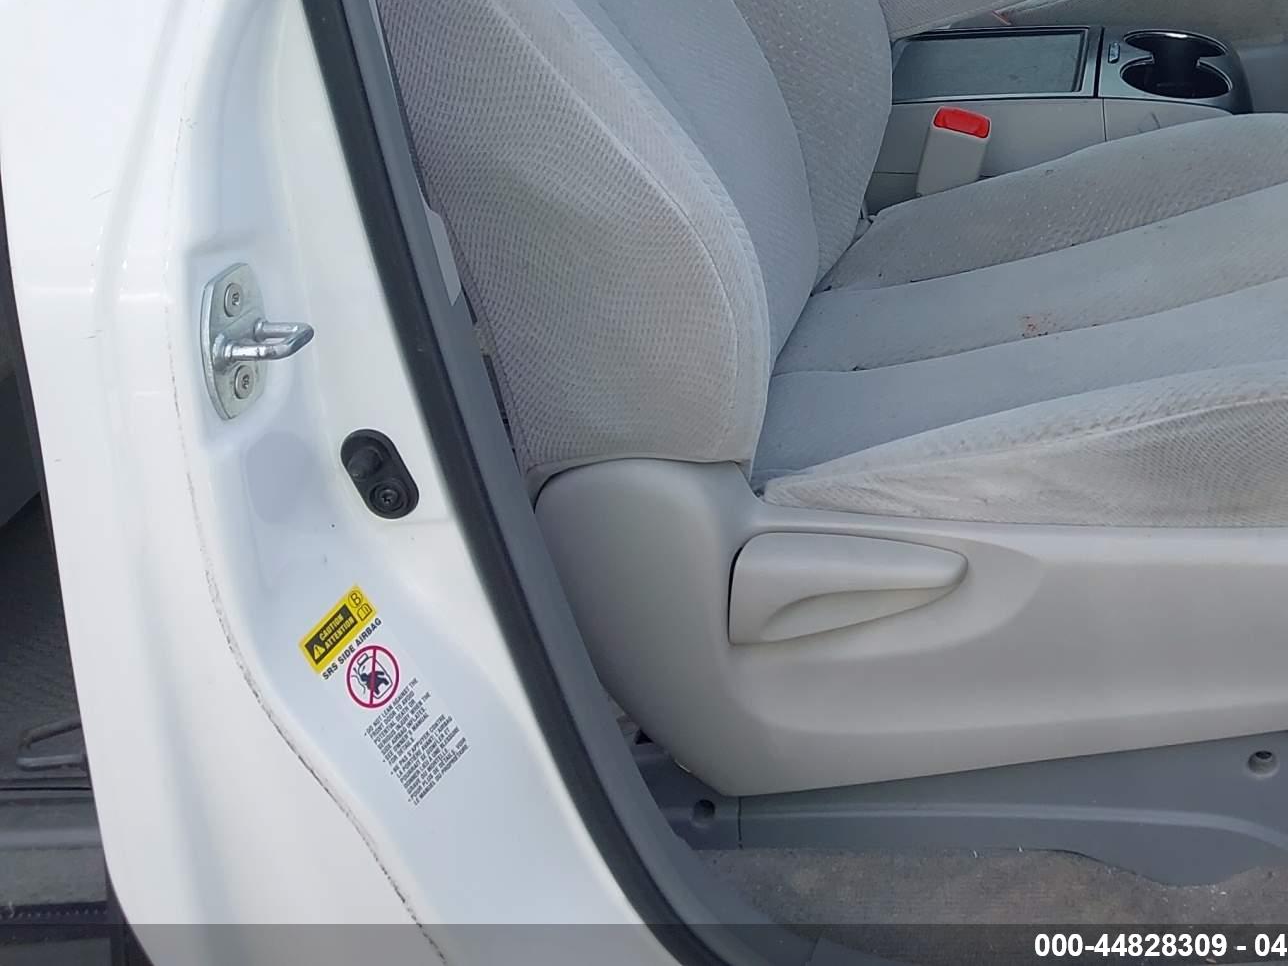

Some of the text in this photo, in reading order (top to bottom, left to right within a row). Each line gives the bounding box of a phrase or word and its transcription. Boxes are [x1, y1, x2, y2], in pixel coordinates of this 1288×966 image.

[319, 613, 344, 641] CAUTION
[323, 616, 355, 650] ATTENTION
[322, 617, 382, 680] SRS SIDE AIRBAG
